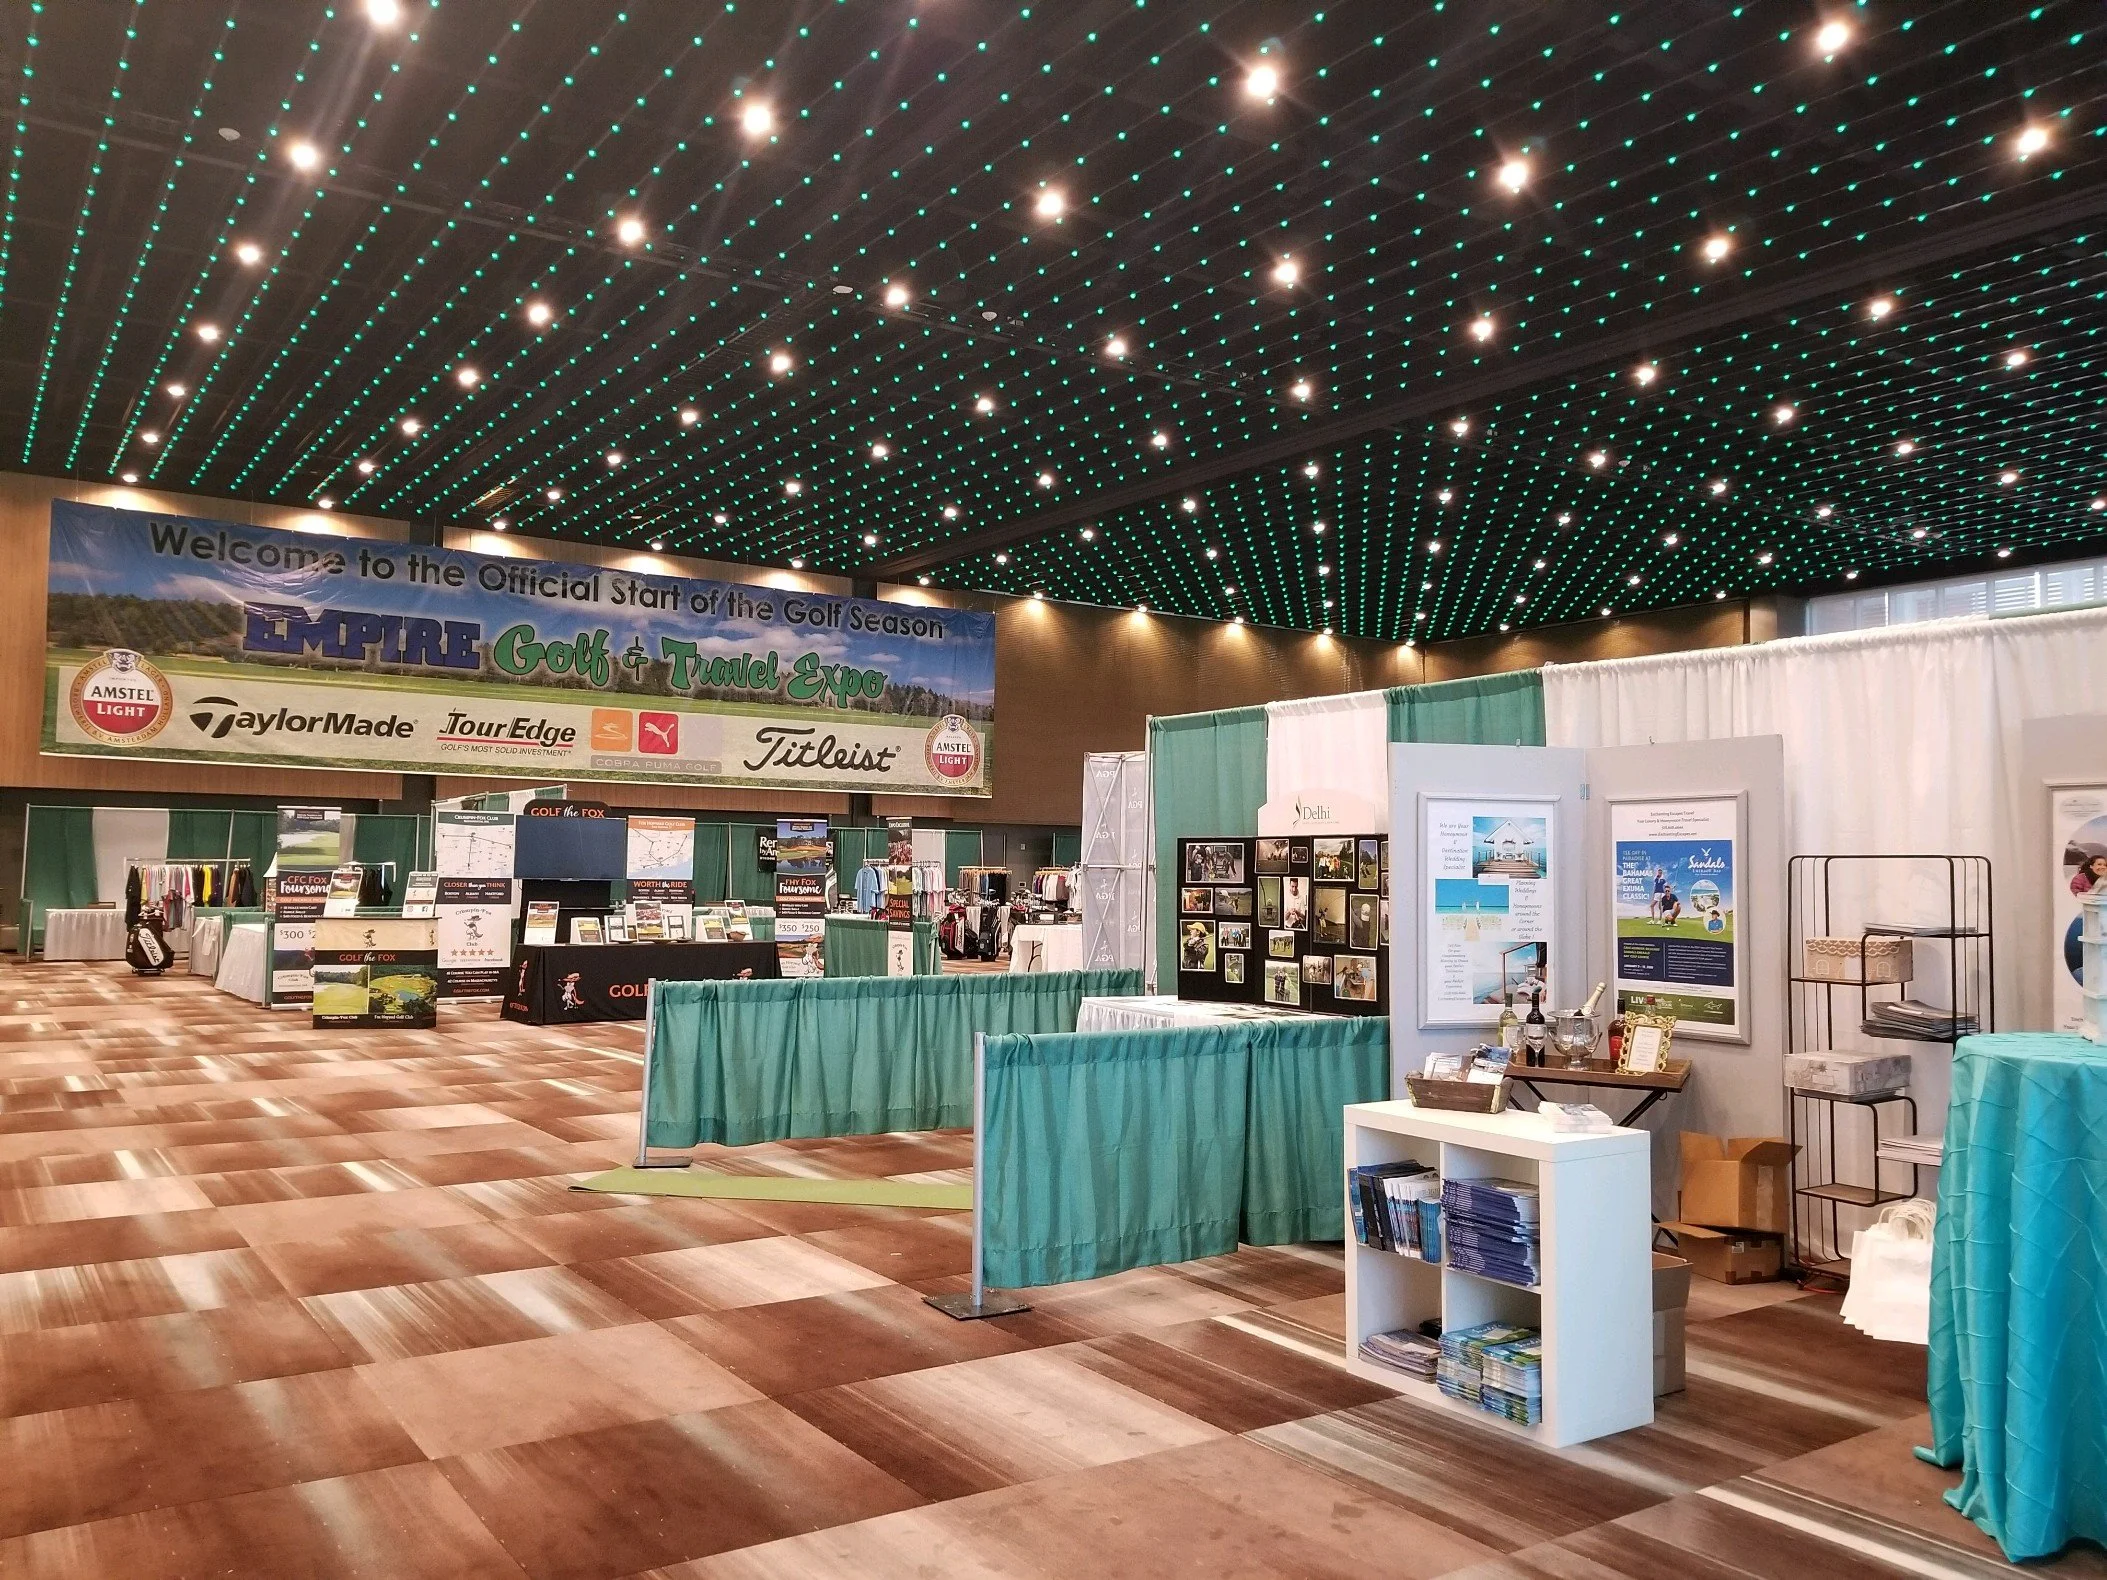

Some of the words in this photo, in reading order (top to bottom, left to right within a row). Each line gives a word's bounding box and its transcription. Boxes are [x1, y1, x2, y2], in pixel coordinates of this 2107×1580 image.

[150, 522, 346, 575] Welcome
[358, 549, 395, 579] to
[407, 553, 465, 587] the
[478, 563, 599, 602] Official
[610, 577, 681, 611] Start
[690, 588, 719, 615] of
[727, 591, 774, 621] the
[784, 599, 843, 628] Golf
[849, 604, 943, 639] Season
[242, 600, 481, 670] EMPIRE
[494, 624, 610, 687] Golf
[661, 636, 781, 690] Travel
[787, 651, 889, 709] Expo
[90, 685, 155, 702] AMSTEL
[96, 702, 146, 717] LIGHT
[189, 696, 415, 739] TaylorMade
[440, 707, 508, 738] Tour
[509, 716, 577, 748] Edge
[440, 743, 470, 752] GOLF'S
[470, 745, 494, 753] MOST
[494, 746, 518, 755] SOLID
[519, 748, 567, 758] INVESTMENT
[743, 726, 897, 773] Titleist
[936, 742, 971, 753] AMSTEL
[595, 757, 640, 769] COBRA
[645, 760, 682, 771] PUMA
[685, 762, 718, 773] GOLF
[939, 754, 968, 765] LIGHT
[530, 807, 562, 817] GOLF
[563, 805, 580, 818] the
[582, 808, 605, 818] FOX
[1302, 805, 1330, 820] Delhi
[1687, 854, 1726, 869] Sandals
[1622, 869, 1653, 877] BAHAMAS
[287, 875, 307, 884] CFC
[308, 876, 327, 885] FOX
[633, 880, 661, 888] WORTH
[785, 878, 800, 886] FHY
[800, 878, 817, 886] FOX
[779, 881, 823, 895] Foursome
[279, 929, 304, 939] $300
[779, 923, 798, 932] $350
[801, 923, 820, 932] $250
[339, 953, 364, 962] GOLF
[363, 952, 376, 963] the
[377, 953, 396, 962] FOX
[1630, 995, 1644, 1004] LIV
